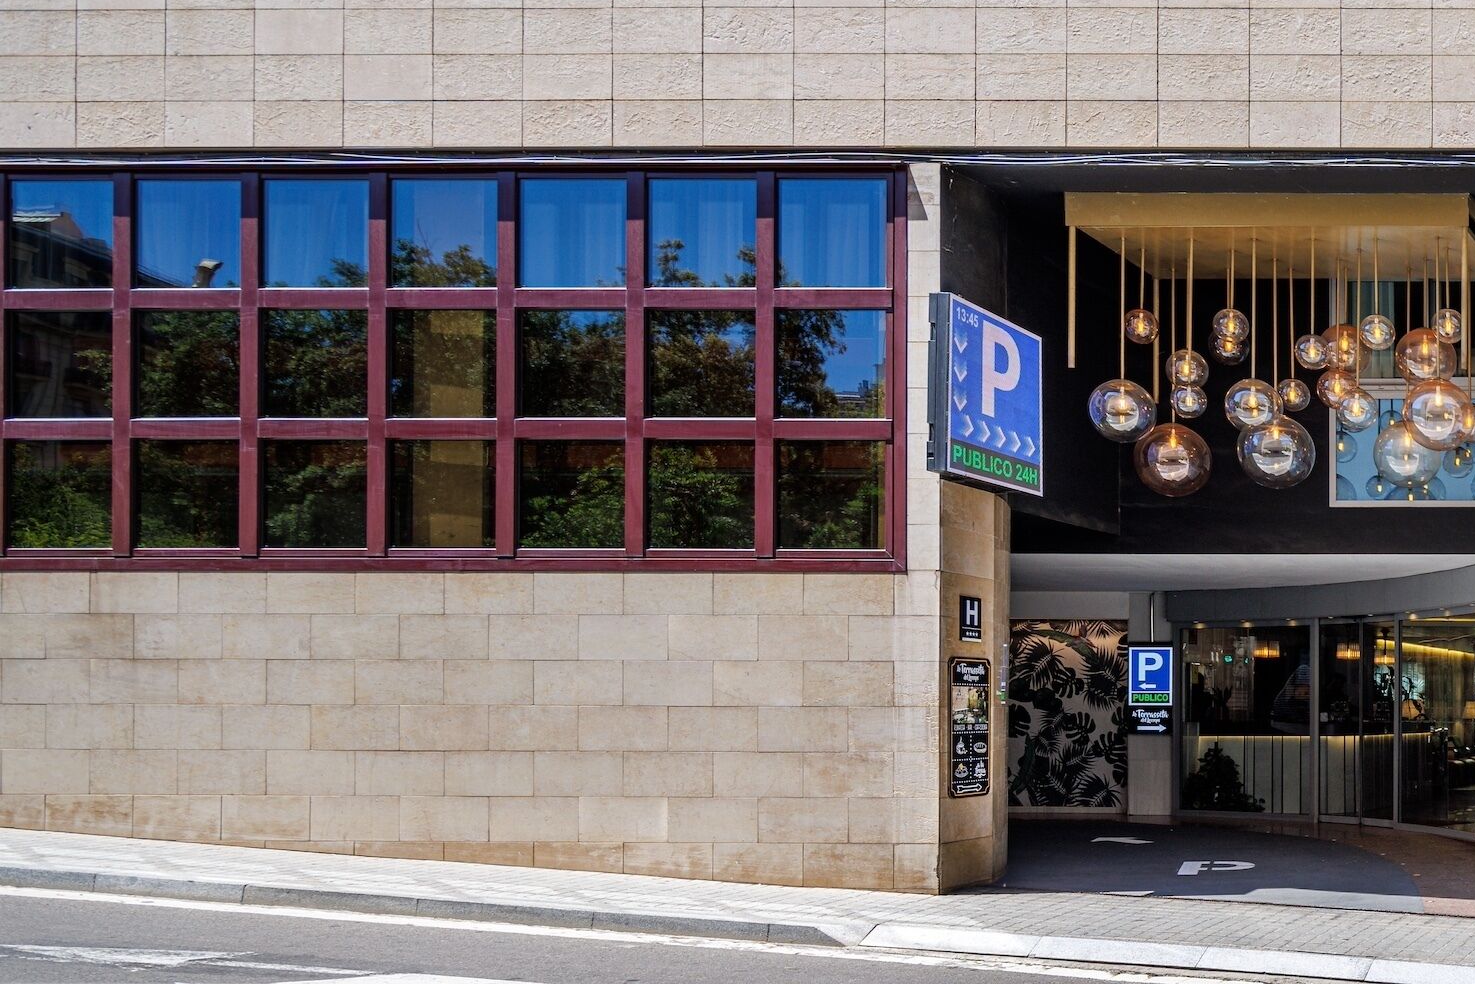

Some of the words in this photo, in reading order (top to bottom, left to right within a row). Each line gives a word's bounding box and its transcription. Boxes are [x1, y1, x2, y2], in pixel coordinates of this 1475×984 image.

[955, 306, 979, 328] 13:45
[981, 319, 1021, 418] P
[953, 445, 1012, 479] PUBLICO
[1015, 465, 1038, 486] 24H
[966, 600, 979, 626] H
[1138, 652, 1164, 681] P
[1132, 693, 1169, 702] PUBLICO
